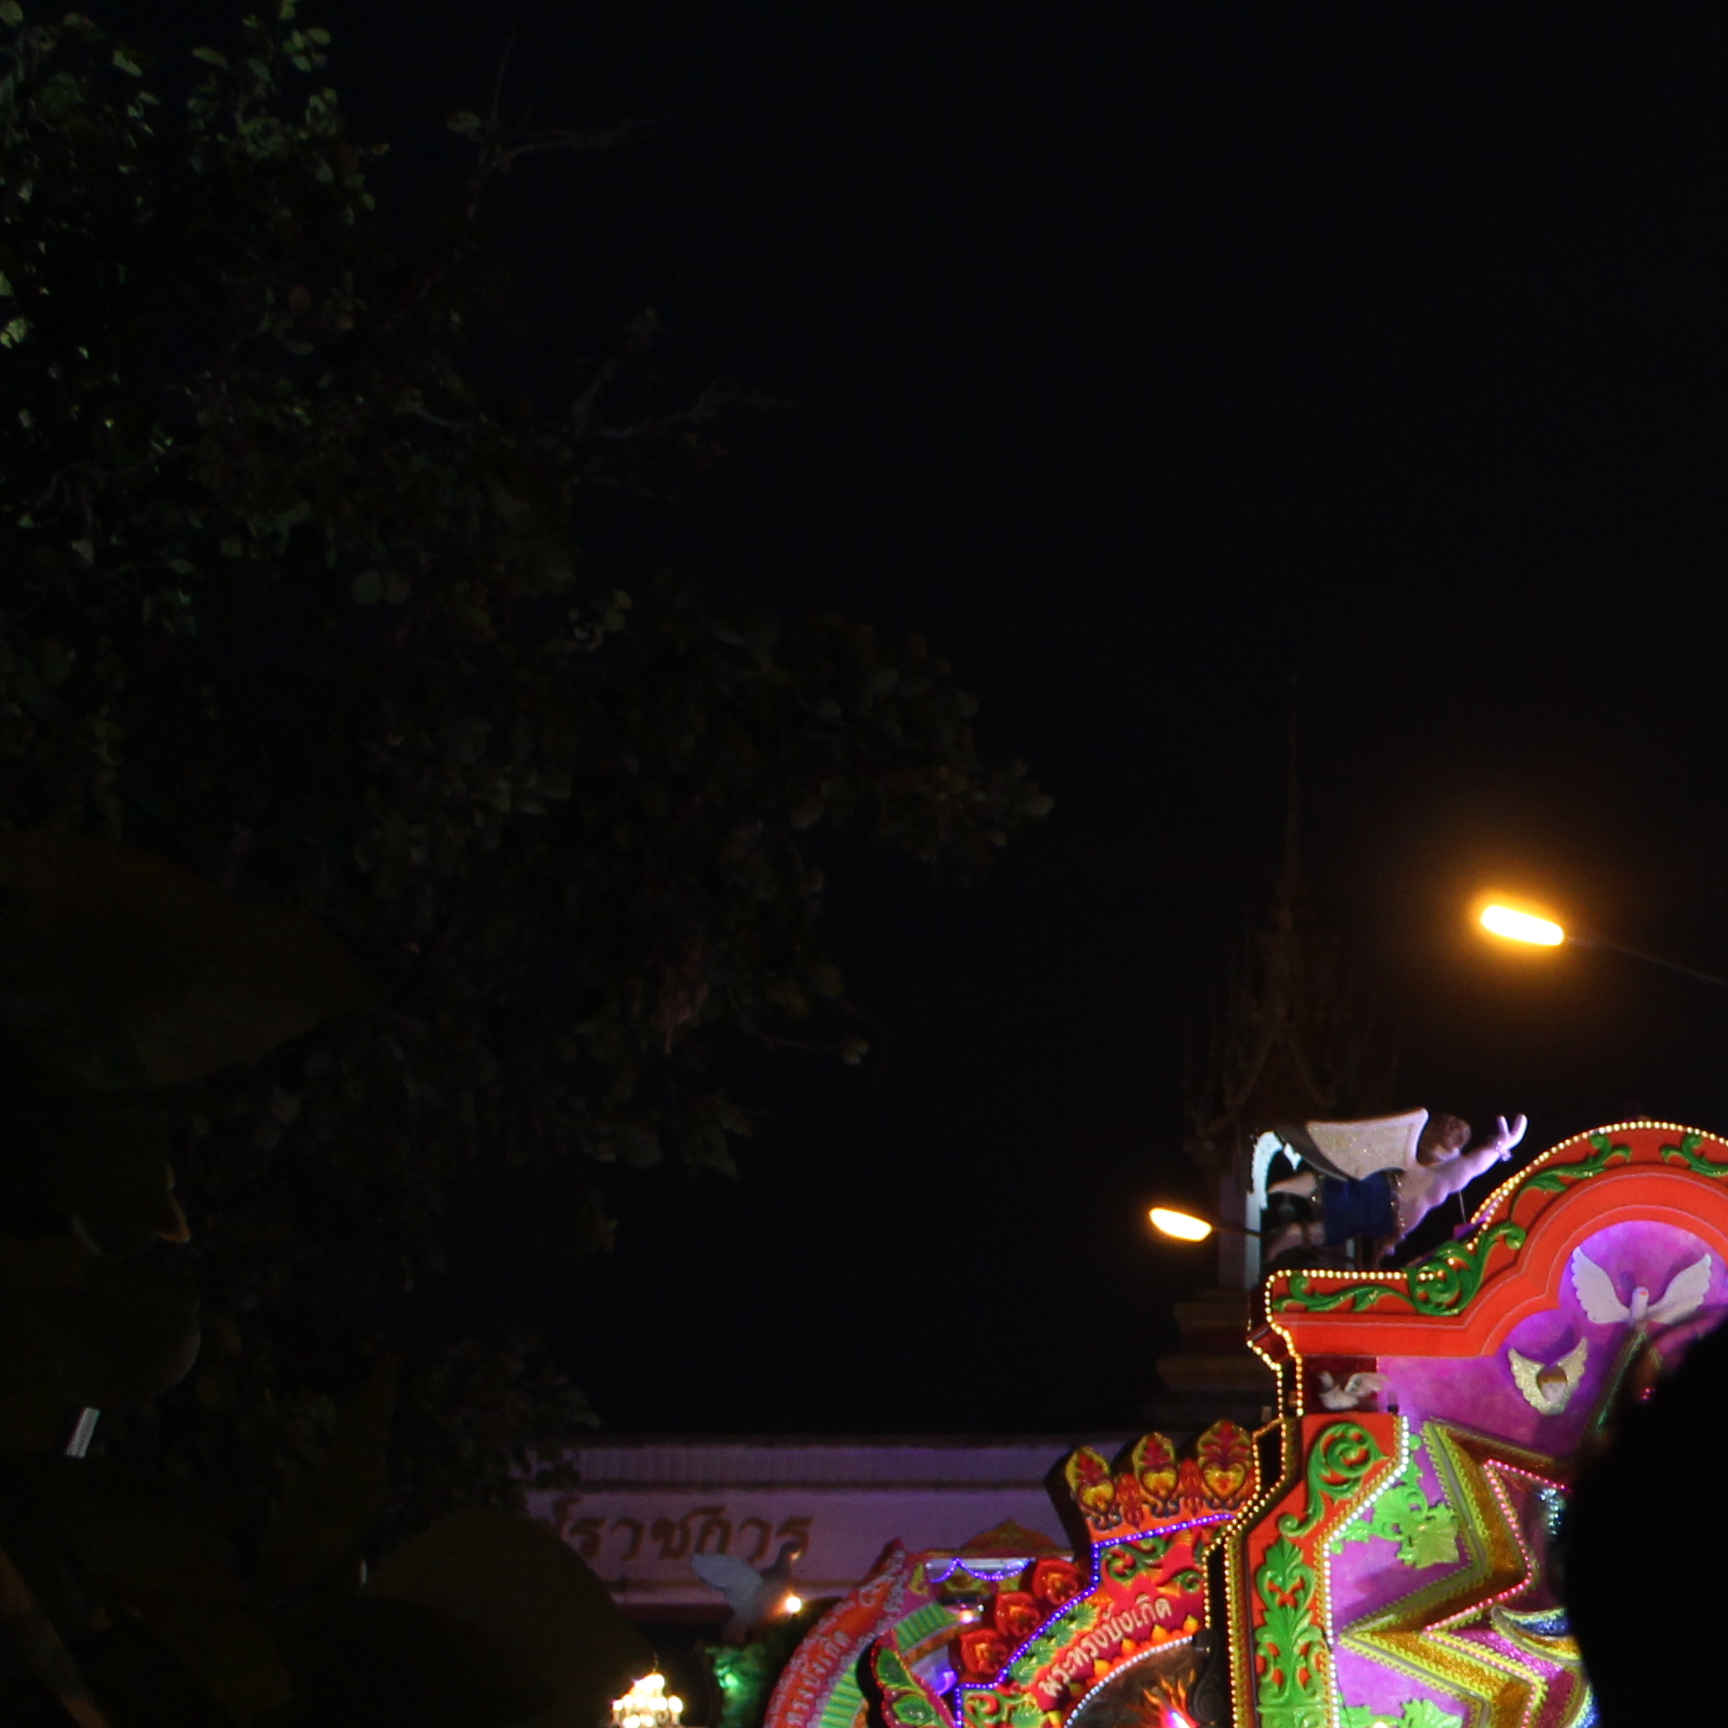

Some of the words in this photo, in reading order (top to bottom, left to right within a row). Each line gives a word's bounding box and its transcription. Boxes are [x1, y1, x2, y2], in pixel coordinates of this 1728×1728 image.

[1037, 1594, 1173, 1698] พระทรงบังเกิด
